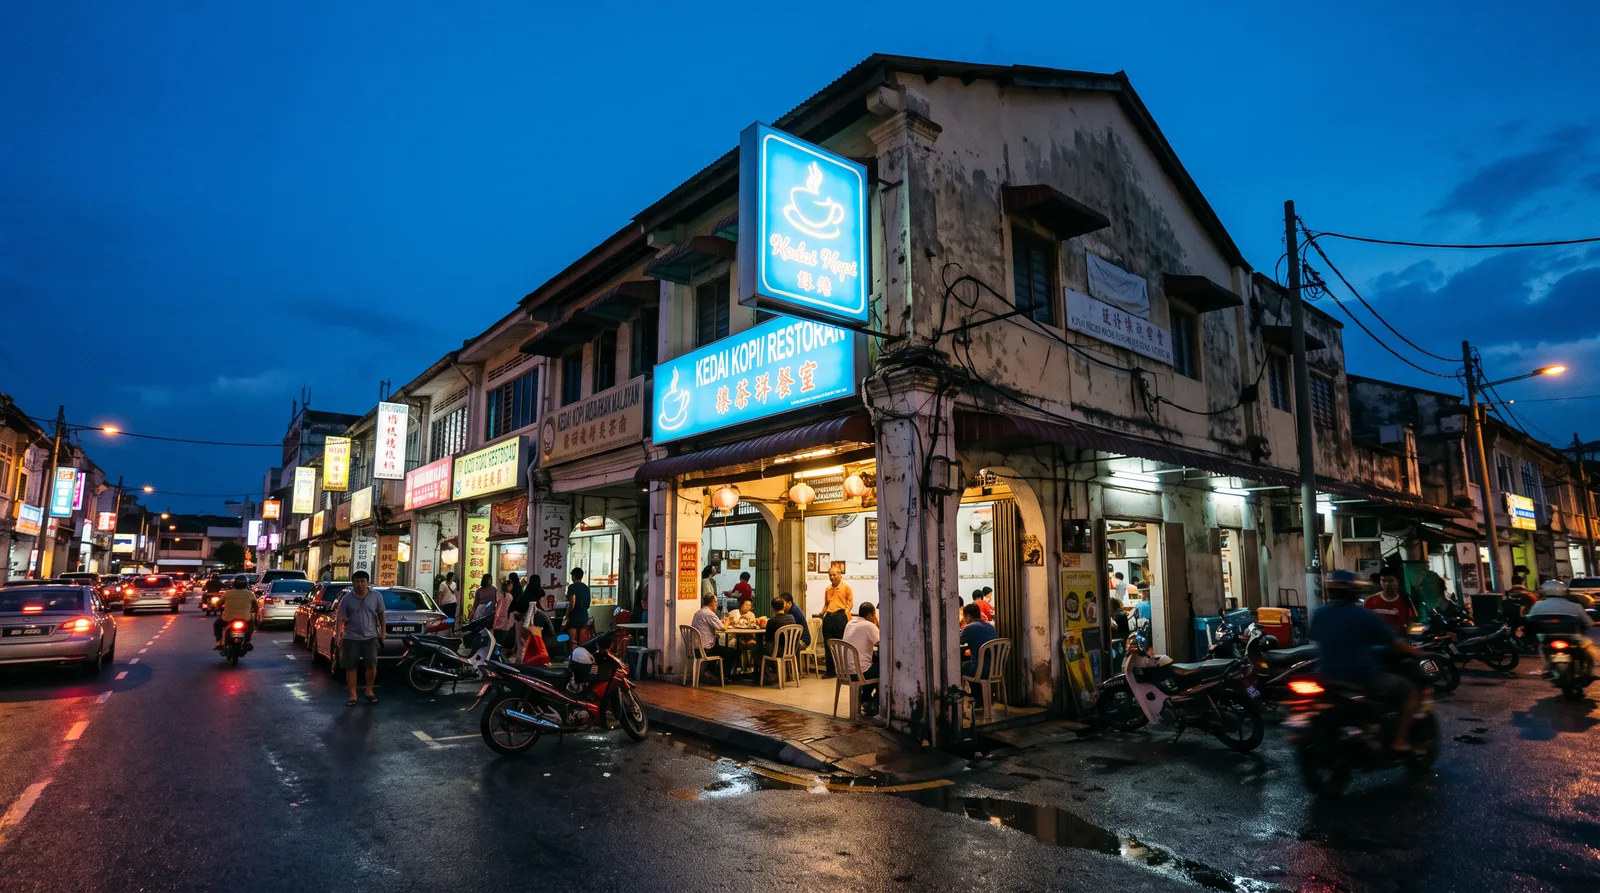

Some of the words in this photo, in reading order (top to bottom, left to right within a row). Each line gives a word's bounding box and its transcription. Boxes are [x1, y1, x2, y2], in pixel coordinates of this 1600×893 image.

[770, 233, 817, 266] Kedai
[820, 248, 857, 282] Kopi
[696, 351, 728, 388] KEDAI
[731, 336, 765, 375] KOPI/
